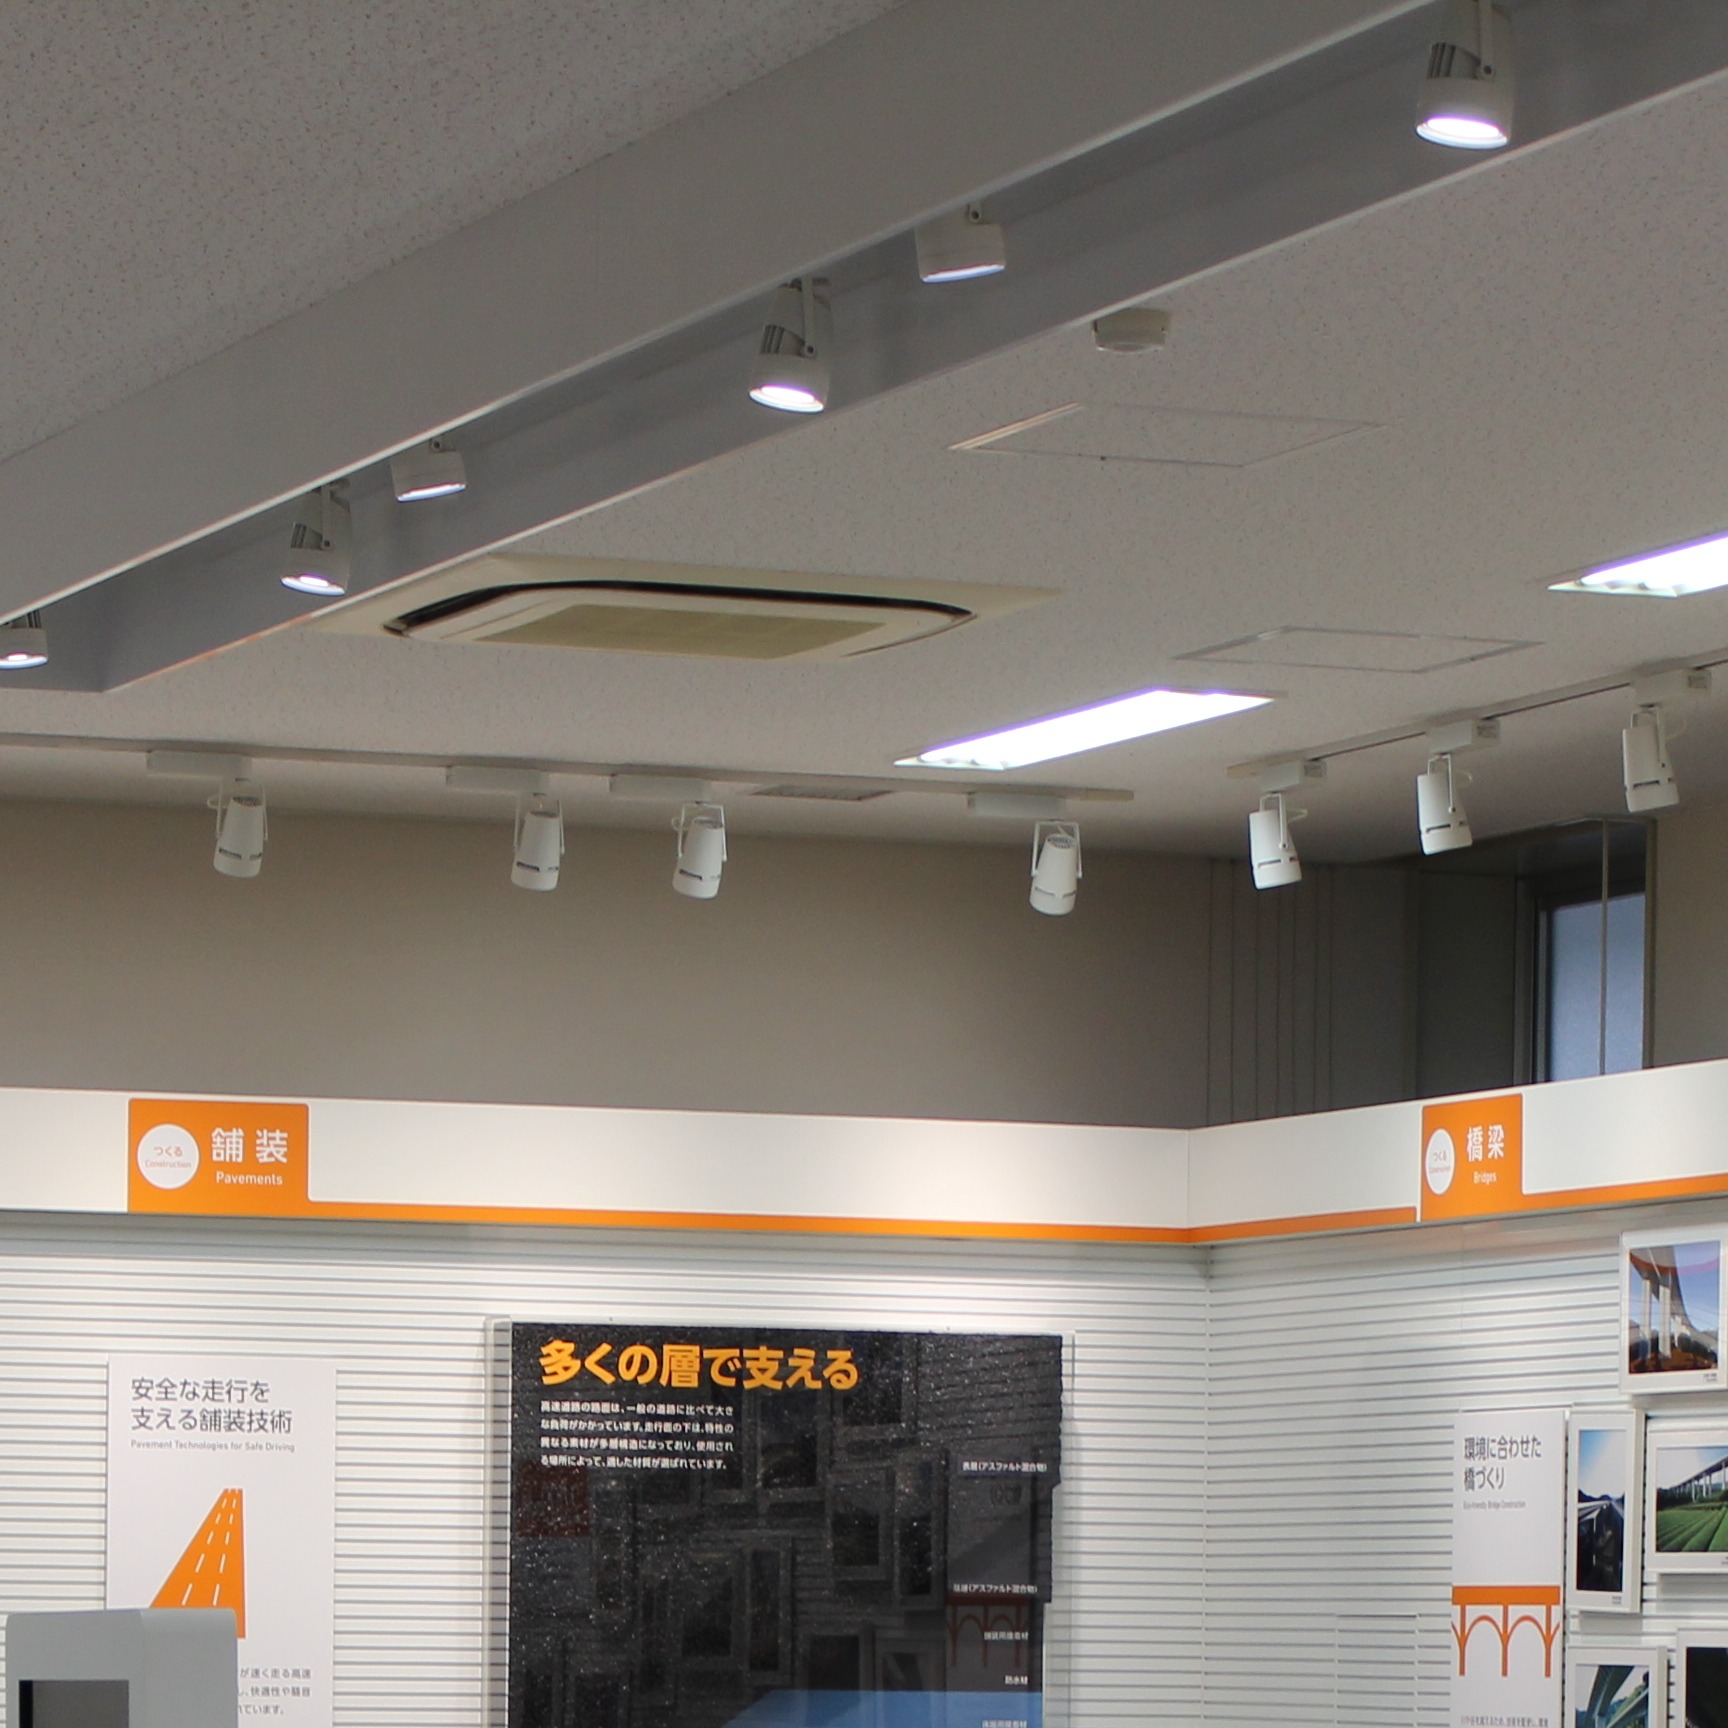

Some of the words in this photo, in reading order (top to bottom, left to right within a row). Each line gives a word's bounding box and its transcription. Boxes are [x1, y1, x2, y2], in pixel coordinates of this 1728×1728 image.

[153, 1146, 183, 1157] つくる
[1466, 1124, 1504, 1162] 橋梁
[145, 1160, 192, 1169] Construction
[215, 1171, 283, 1185] Pavements
[538, 1339, 859, 1390] 多くの層で支える
[131, 1377, 270, 1403] 安全な走行を
[131, 1406, 292, 1433] 支える舗装技術
[131, 1439, 172, 1449] Pavement
[175, 1440, 228, 1451] Technologies
[230, 1440, 242, 1449] for
[245, 1441, 263, 1451] Safe
[265, 1443, 295, 1453] Driving
[1464, 1434, 1541, 1460] 環境に合わせた
[1464, 1466, 1505, 1492] 橋づくり
